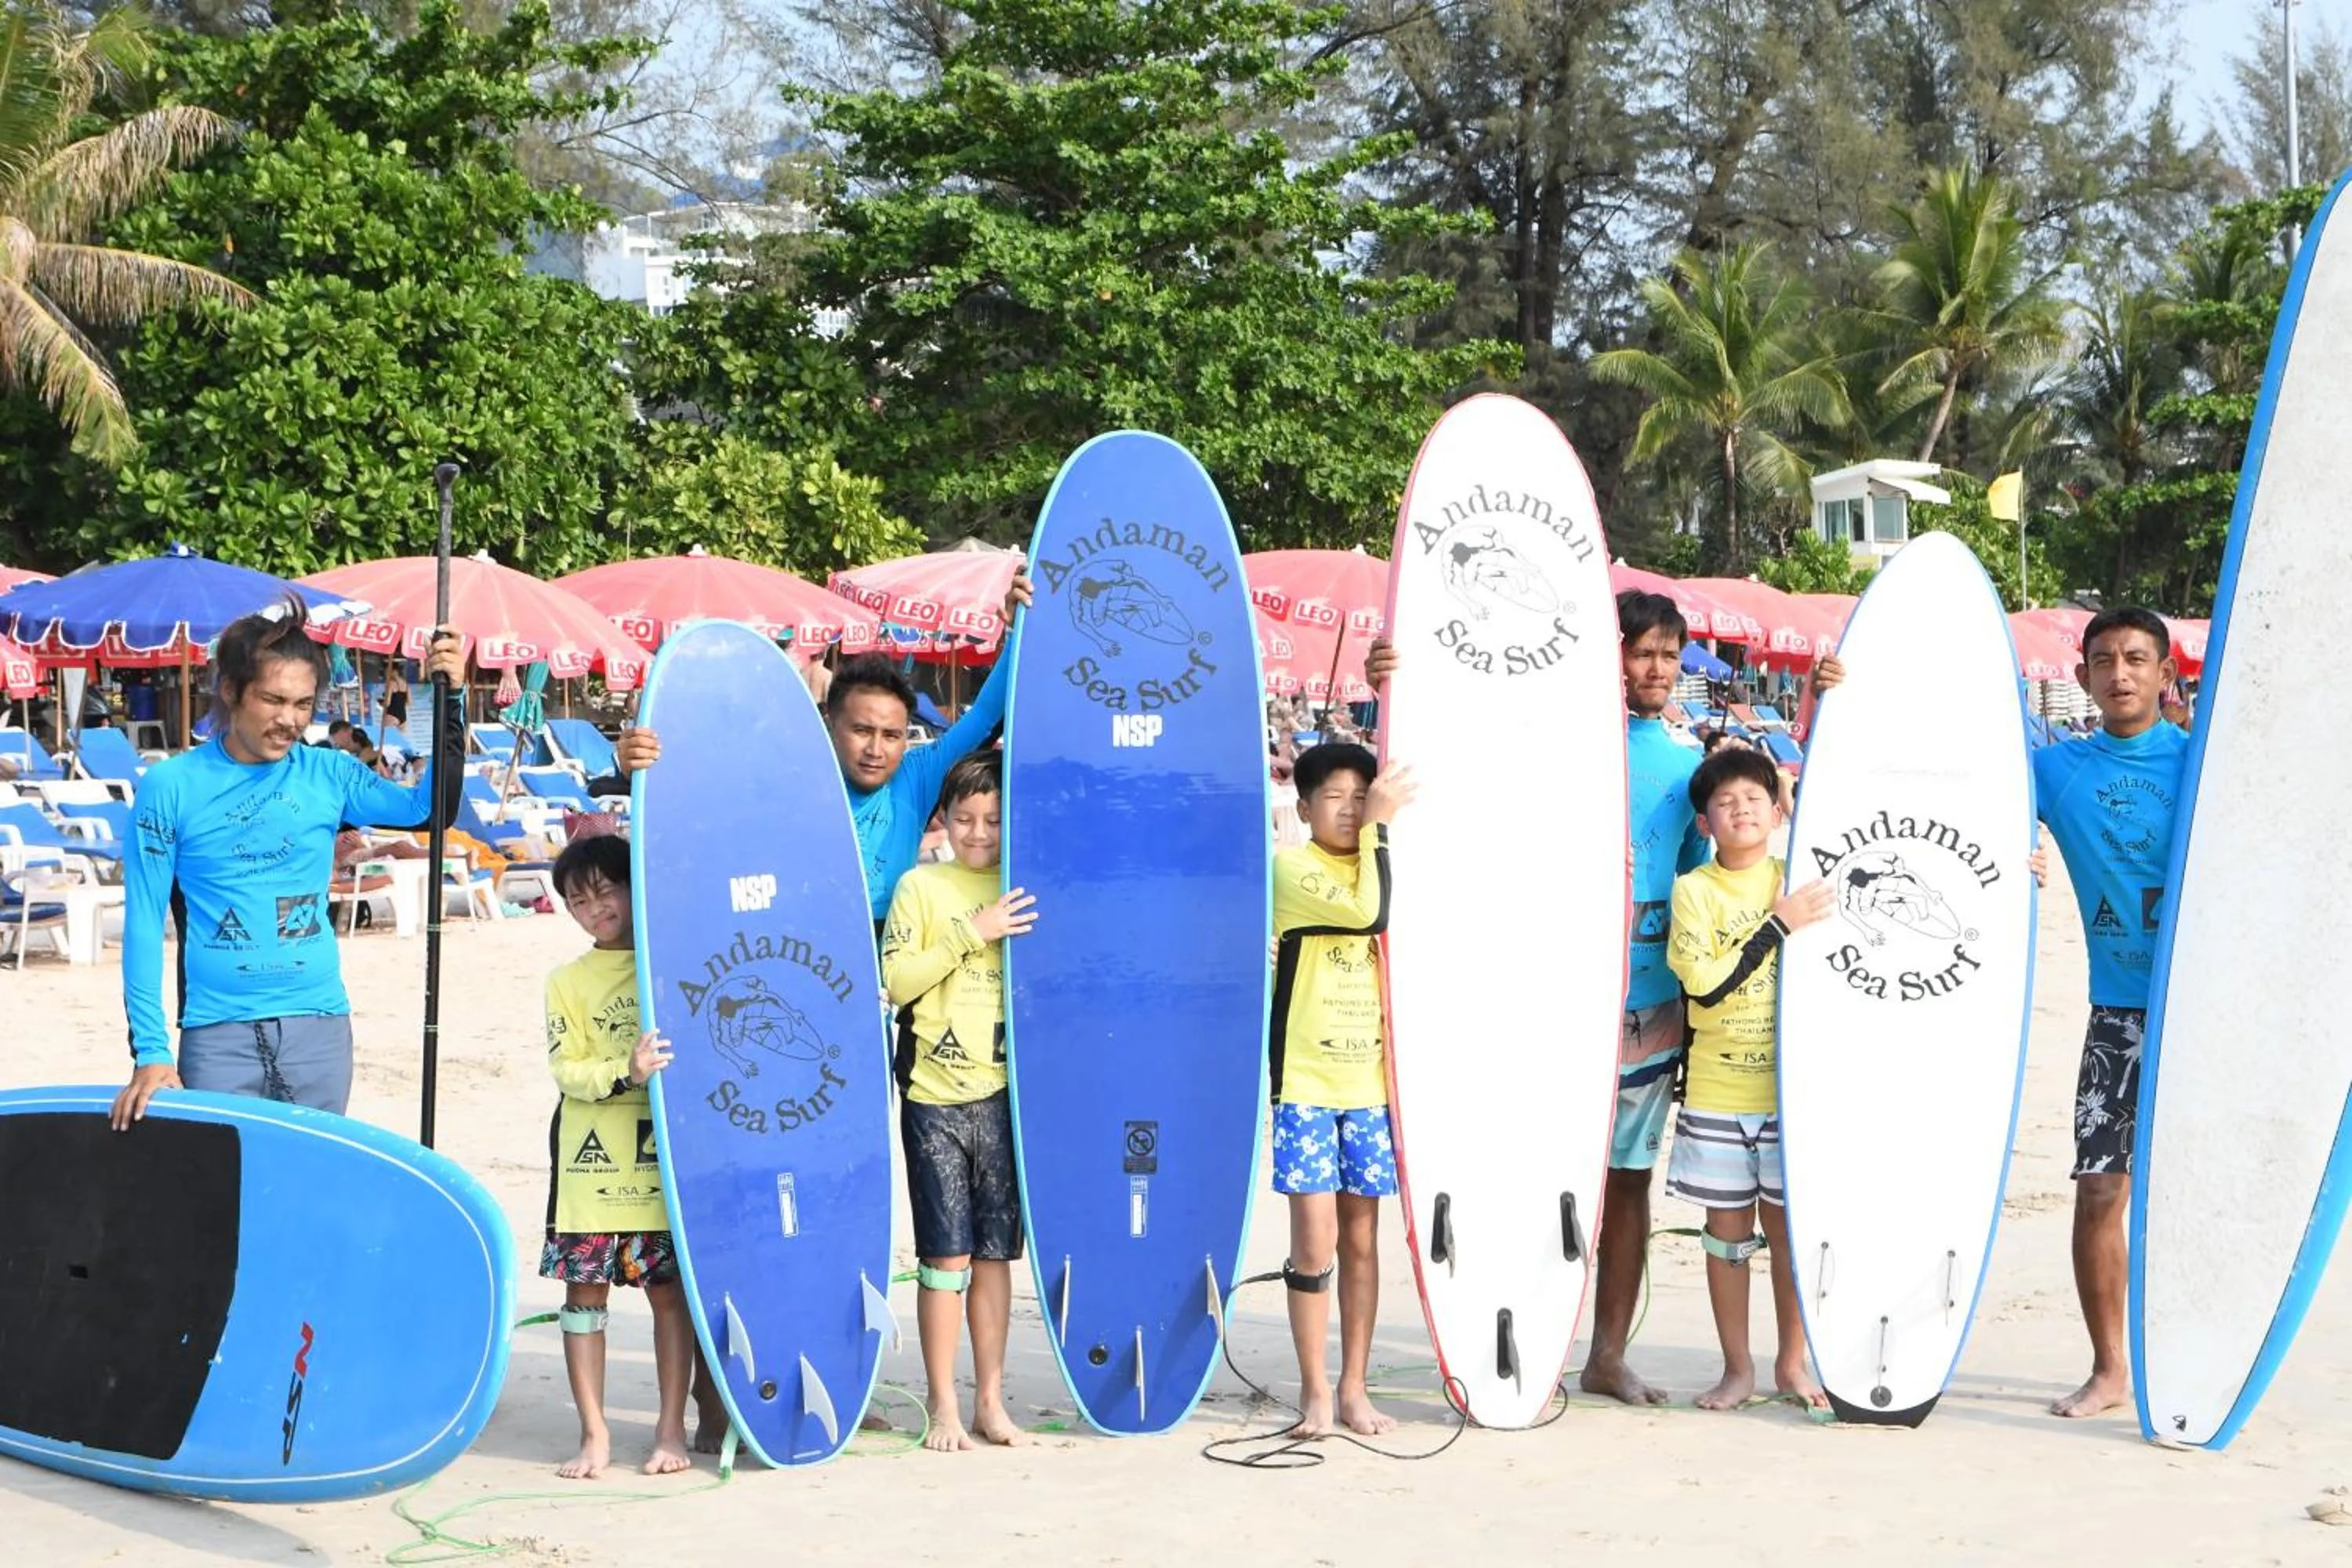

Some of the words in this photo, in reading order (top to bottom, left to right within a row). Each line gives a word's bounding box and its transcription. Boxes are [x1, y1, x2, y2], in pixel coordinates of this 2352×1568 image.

[1414, 484, 1594, 564] Andaman
[1038, 517, 1230, 594] Andaman
[858, 590, 884, 611] LEO
[899, 600, 935, 620] LEO
[1252, 591, 1281, 611] LEO
[953, 611, 994, 630] LEO
[1298, 603, 1334, 622] LEO
[351, 620, 393, 641] LEO
[612, 618, 651, 641] EO
[846, 624, 867, 642] LEO
[488, 642, 535, 658] LEO
[1433, 619, 1494, 674] Sea
[1504, 617, 1579, 676] Surf
[556, 652, 593, 669] LEO
[610, 660, 638, 680] LEO
[1062, 656, 1127, 711] Sea
[1138, 648, 1217, 712] Surf
[1112, 714, 1163, 747] NSP
[2096, 775, 2173, 811] Andaman
[1811, 810, 2001, 889] Andaman
[730, 874, 777, 913] NSP
[678, 931, 854, 1017] Andaman
[1825, 944, 1888, 1000] Sea
[1898, 943, 1982, 1002] Surf
[1345, 1037, 1368, 1051] ISA
[1744, 1053, 1766, 1063] ISA
[706, 1080, 768, 1134] Sea
[775, 1062, 848, 1133] Surf
[616, 1186, 640, 1196] ISA
